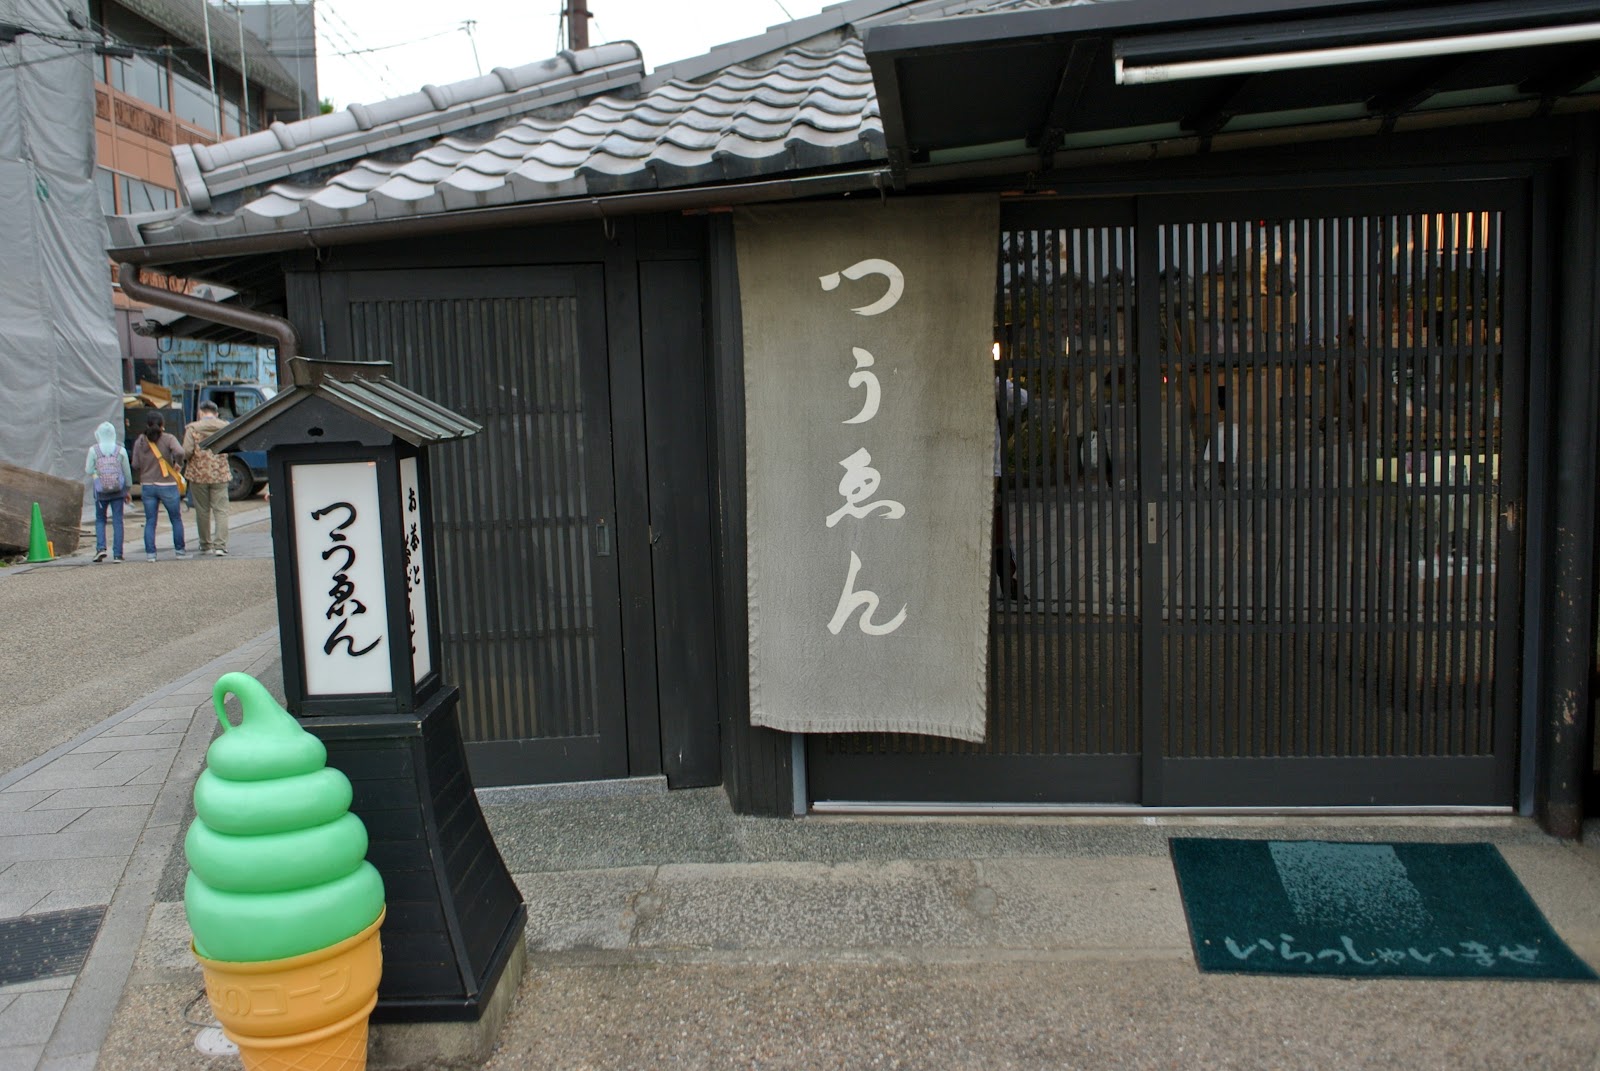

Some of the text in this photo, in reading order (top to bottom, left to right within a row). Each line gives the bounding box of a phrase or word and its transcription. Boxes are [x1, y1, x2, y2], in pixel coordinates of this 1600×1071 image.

[818, 257, 908, 637] つうゑん
[310, 501, 383, 657] つうゑん
[1224, 933, 1542, 967] いらっしゃいませ
